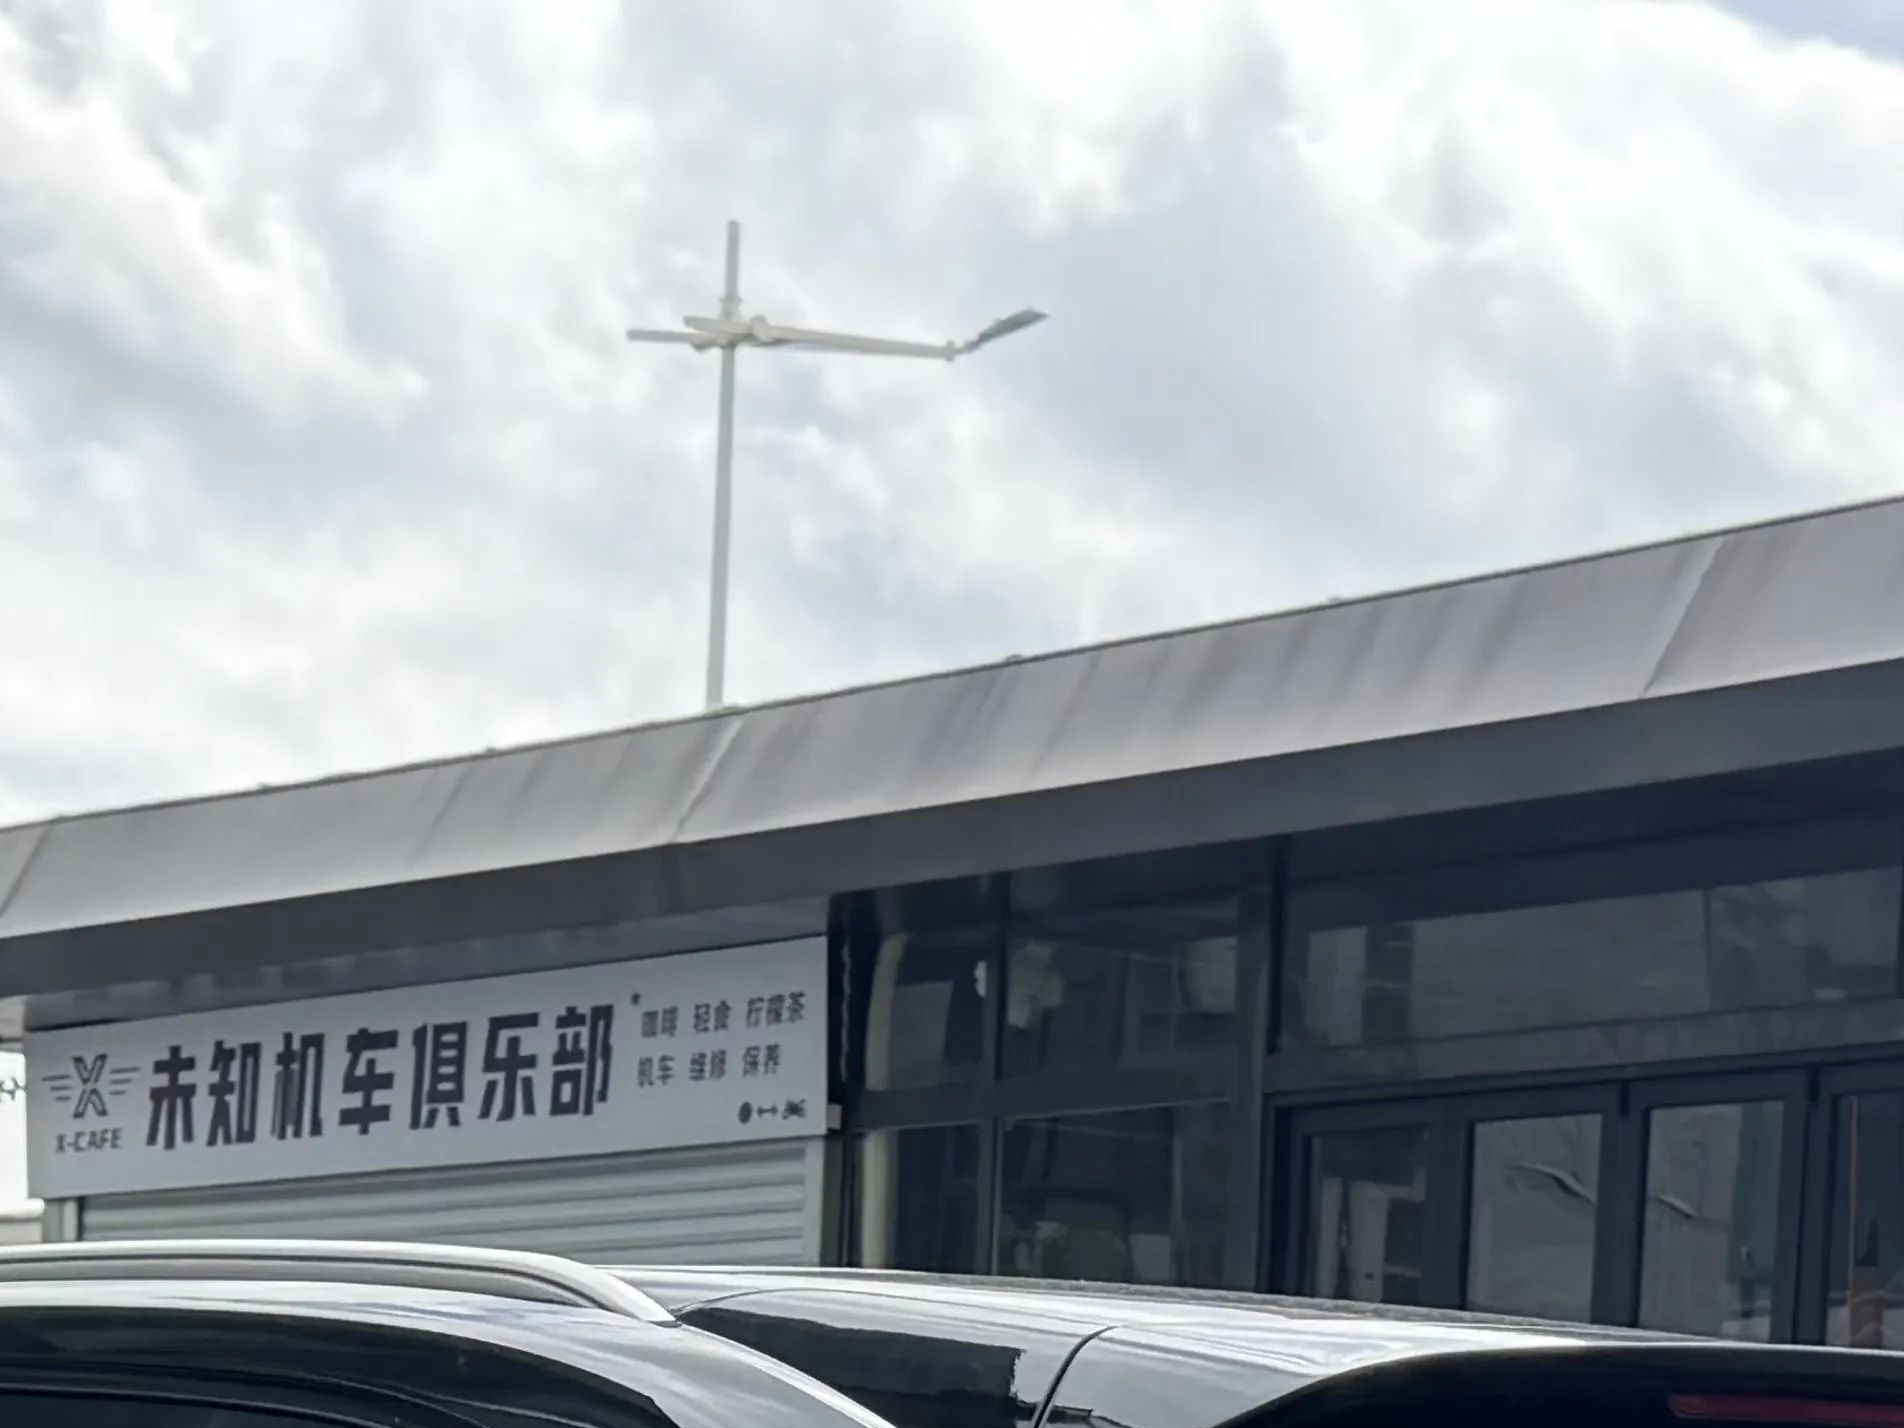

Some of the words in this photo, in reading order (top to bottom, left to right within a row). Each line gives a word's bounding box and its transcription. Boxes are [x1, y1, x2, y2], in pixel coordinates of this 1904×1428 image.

[146, 1004, 615, 1151] 未知机车俱乐部
[637, 1055, 675, 1087] 机车
[55, 1128, 122, 1154] X-CAFE
